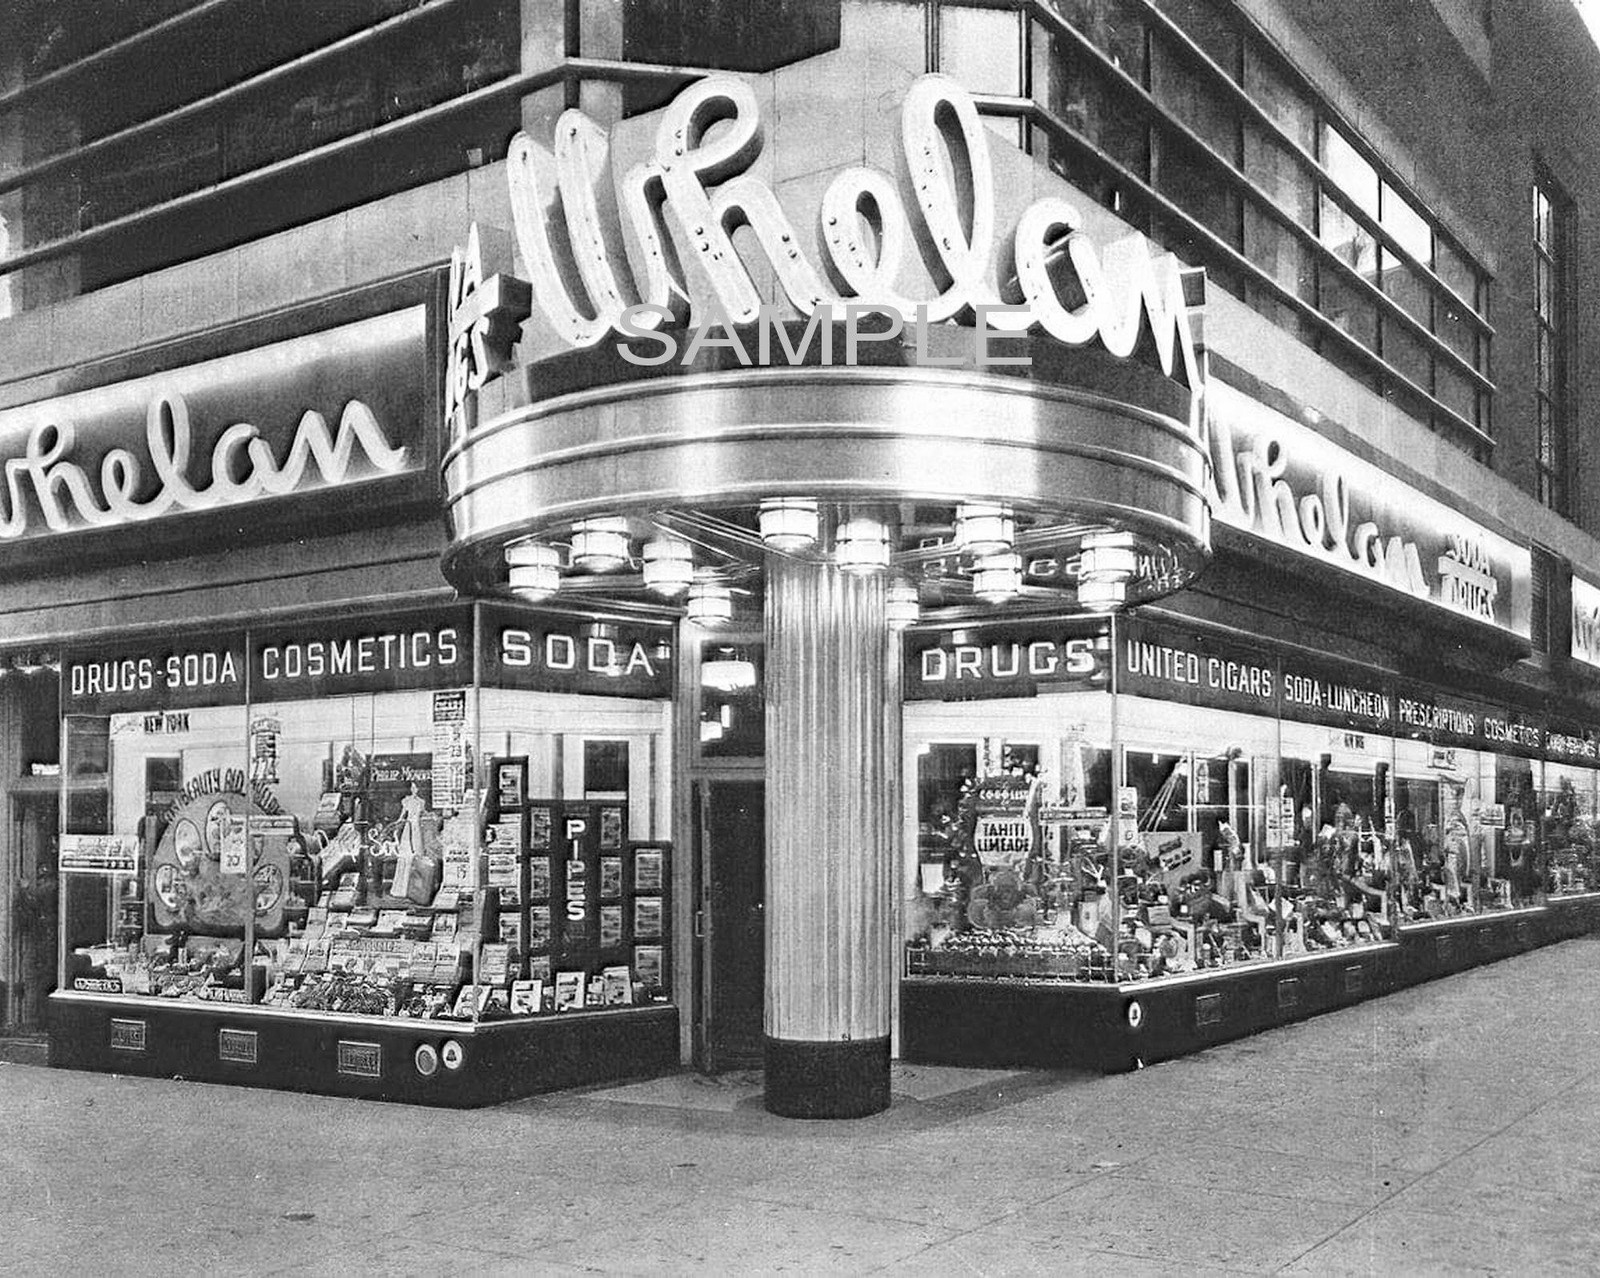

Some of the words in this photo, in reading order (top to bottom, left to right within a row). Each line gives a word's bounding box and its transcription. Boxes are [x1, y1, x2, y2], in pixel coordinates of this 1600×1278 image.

[506, 72, 1206, 395] Whelan
[262, 628, 459, 680] COSMETICS
[501, 628, 655, 677] SODA
[920, 637, 1096, 683] DRUGS
[1126, 638, 1200, 686] UNITED
[1207, 657, 1273, 699] CIGARS
[144, 715, 164, 734] NEW
[166, 712, 190, 733] YORK
[977, 838, 1030, 853] LIMEADE
[983, 822, 1025, 838] TAHITI
[566, 818, 586, 921] PIPES
